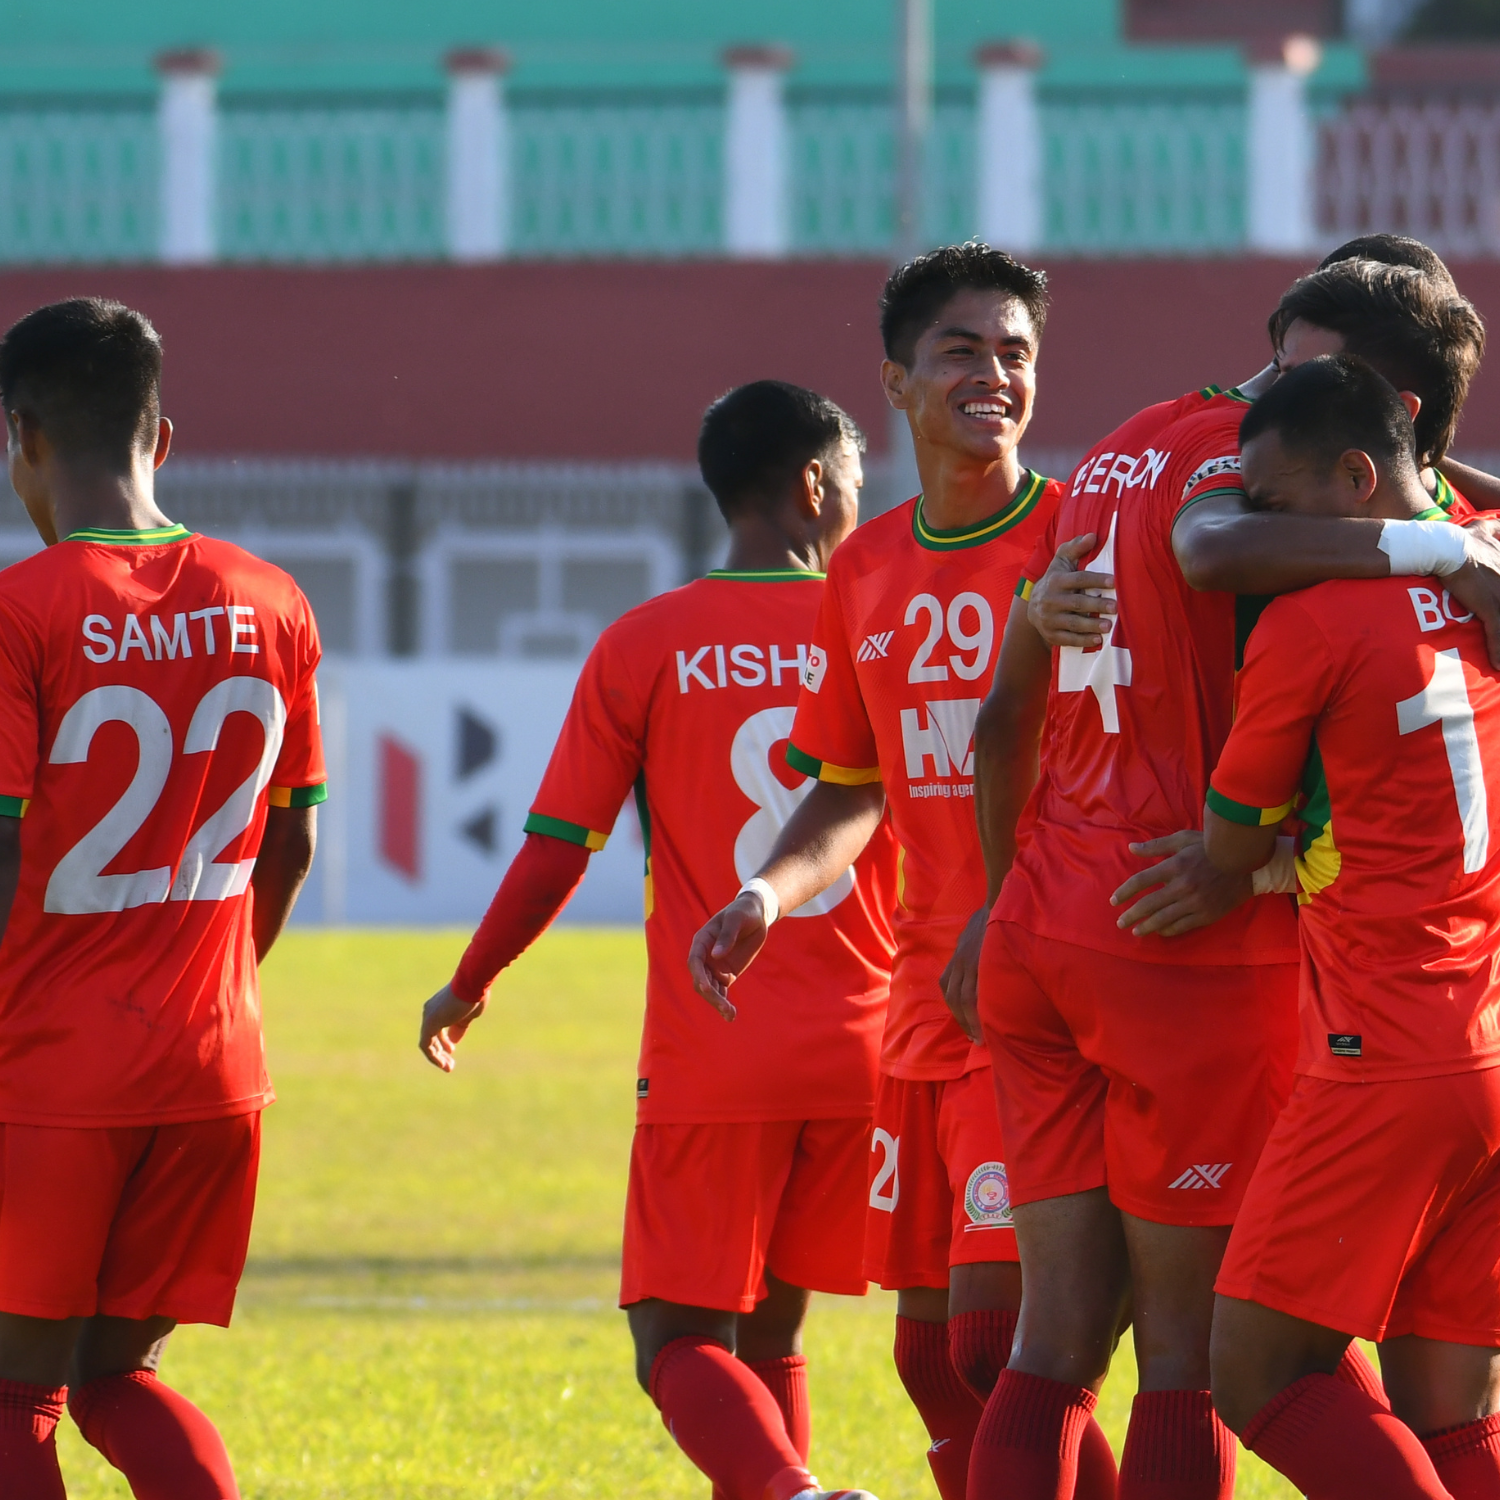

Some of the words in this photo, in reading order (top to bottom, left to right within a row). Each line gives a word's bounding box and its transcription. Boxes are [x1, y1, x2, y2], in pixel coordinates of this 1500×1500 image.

[82, 605, 260, 663] SAMTE
[676, 643, 807, 694] KISH
[903, 591, 994, 684] 29
[1058, 511, 1133, 733] 4
[43, 676, 288, 914] 22
[730, 706, 856, 917] 8
[869, 1127, 900, 1213] 2
